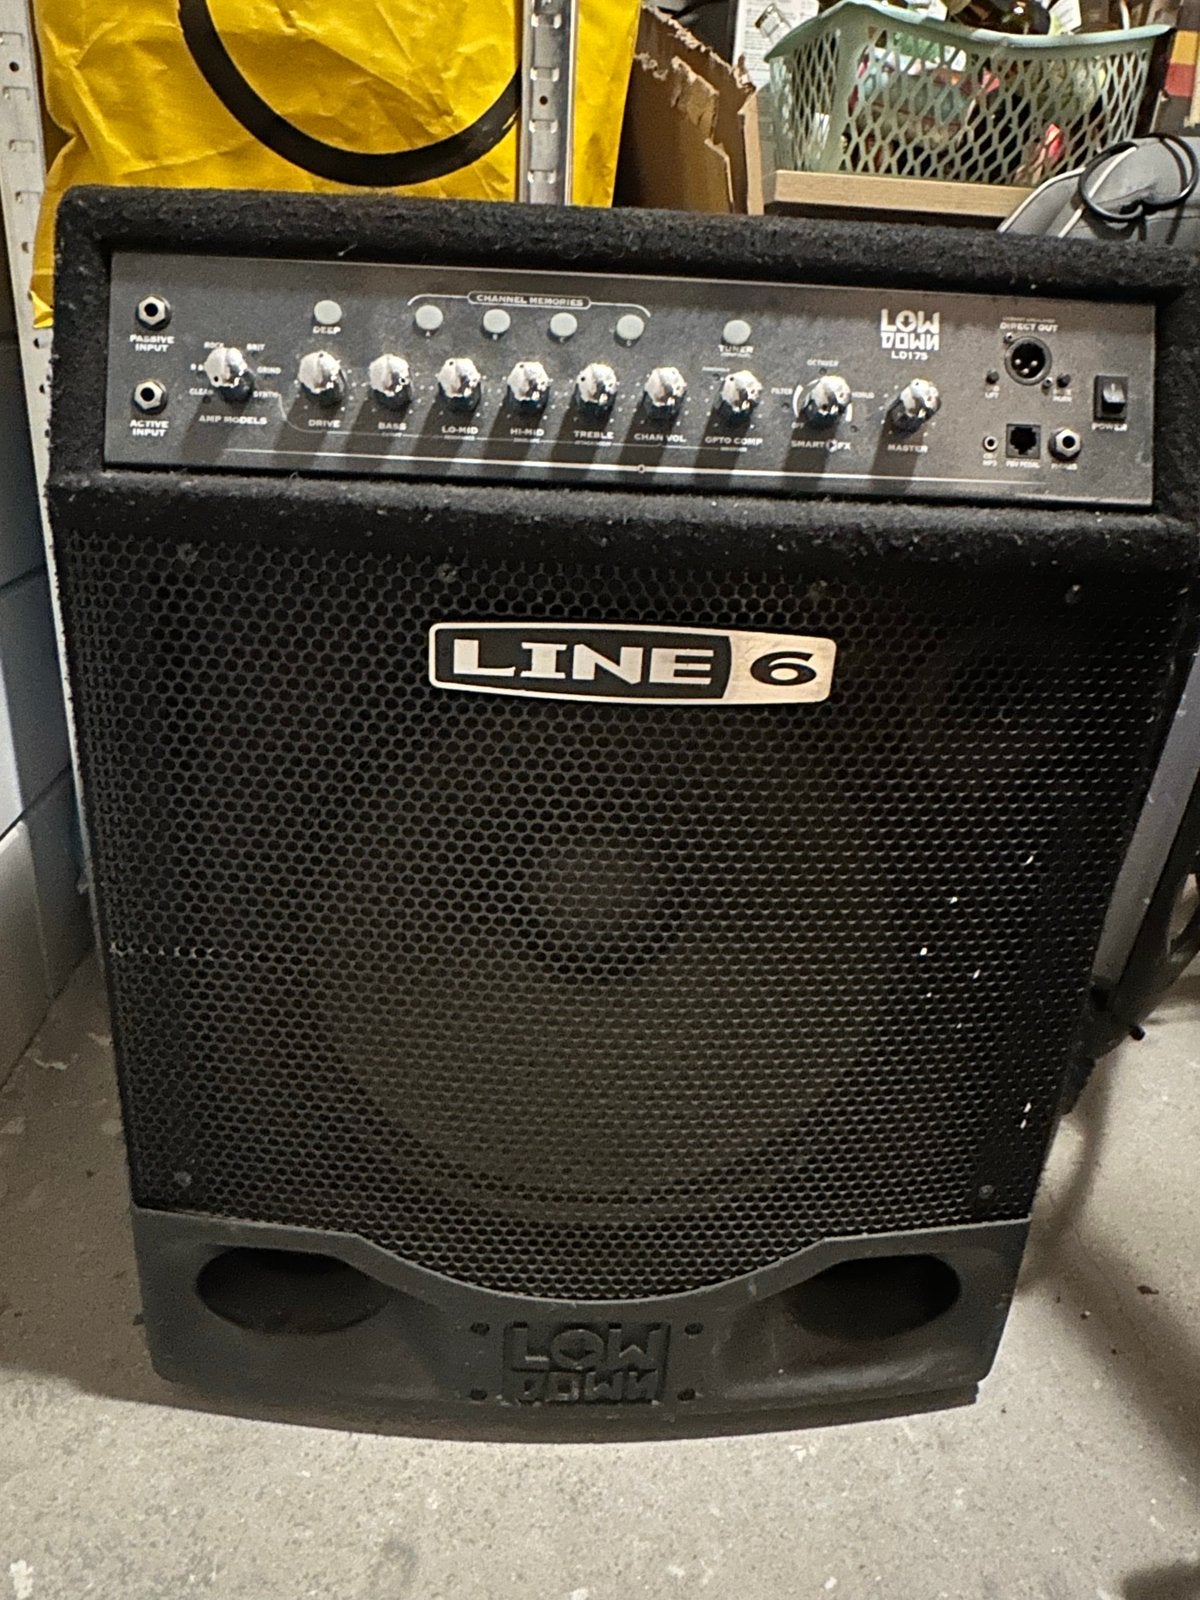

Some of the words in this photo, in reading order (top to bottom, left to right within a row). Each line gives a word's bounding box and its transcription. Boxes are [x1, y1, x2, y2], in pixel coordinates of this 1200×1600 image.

[476, 294, 527, 304] CHANNEL
[529, 297, 584, 307] MEMORIES
[880, 308, 940, 334] LOW
[312, 326, 341, 334] DEEP
[1000, 322, 1036, 331] DIRECT
[1037, 324, 1058, 332] OUT
[129, 334, 175, 344] PASSIVE
[880, 332, 940, 350] DOWN
[135, 344, 169, 352] INPUT
[718, 344, 754, 353] TUNER
[130, 419, 169, 428] ACTIVE
[199, 415, 222, 423] AMP
[223, 416, 267, 425] MODELS
[308, 419, 341, 428] DRIVE
[378, 422, 407, 431] BASS
[441, 426, 479, 434] LO-MID
[132, 428, 167, 437] INPUT
[510, 428, 545, 436] HI-MID
[573, 430, 615, 439] TREBLE
[633, 433, 663, 441] CHAN
[666, 434, 687, 442] VOL
[732, 437, 763, 445] COMP
[791, 440, 825, 449] SMART
[836, 442, 851, 450] FX
[888, 444, 928, 453] MASTER
[453, 638, 715, 685] LINE
[749, 650, 818, 687] 6
[505, 1320, 668, 1371] LOW
